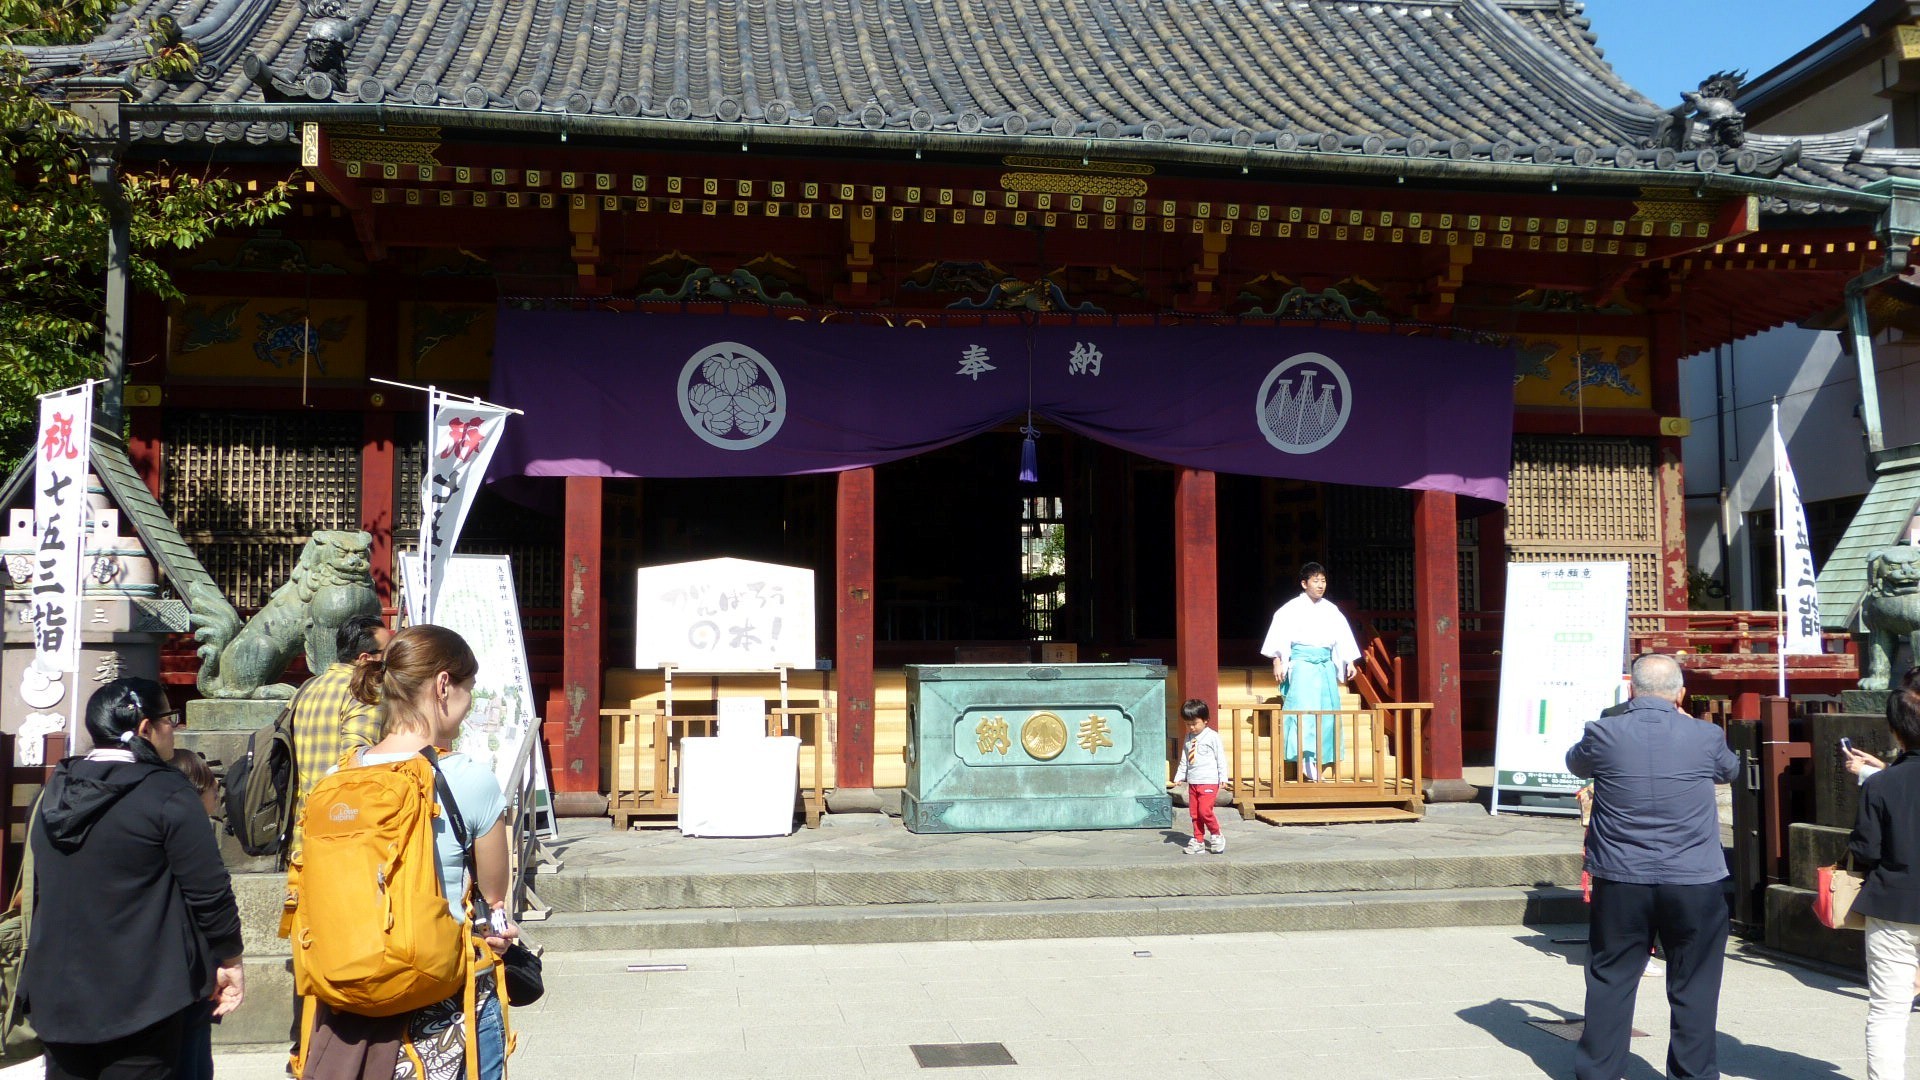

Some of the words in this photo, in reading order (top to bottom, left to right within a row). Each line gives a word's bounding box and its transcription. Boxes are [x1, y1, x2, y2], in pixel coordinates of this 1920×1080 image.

[956, 344, 997, 381] 奉
[1068, 342, 1103, 377] 納
[975, 715, 1012, 755] 納
[1077, 713, 1113, 754] 奉
[339, 807, 359, 815] Lowe
